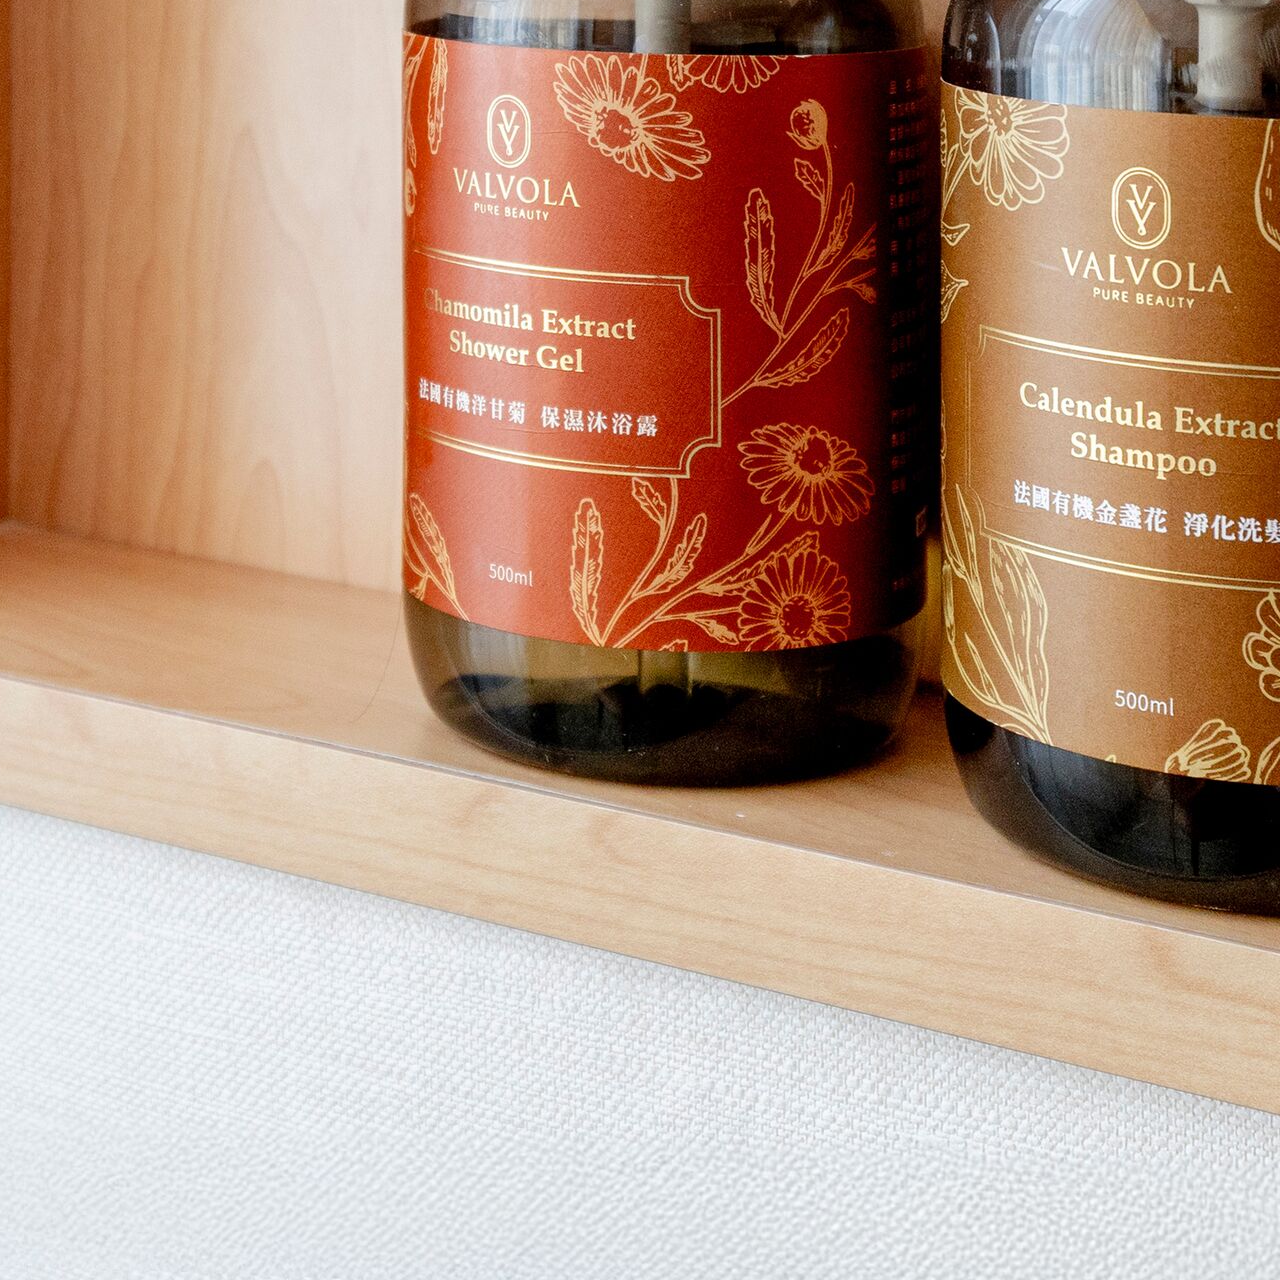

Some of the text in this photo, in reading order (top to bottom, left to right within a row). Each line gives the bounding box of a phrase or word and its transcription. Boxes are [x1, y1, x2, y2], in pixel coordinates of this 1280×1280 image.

[452, 167, 581, 208] VALVOLA
[474, 202, 549, 221] PURE BEAUTY
[1060, 247, 1233, 294] VALVOLA
[423, 287, 637, 341] Chamomila Extract
[1092, 287, 1195, 309] PURE BEAUTY
[449, 329, 585, 373] Shower Gel
[418, 377, 659, 438] 法國有機洋甘菊 保濕沐浴露
[1019, 381, 1163, 431] Calendula
[1070, 431, 1217, 480] Shampoo
[1013, 479, 1168, 534] 法國有機金盞花
[488, 563, 533, 588] 500ml
[1114, 689, 1174, 717] 500ml
